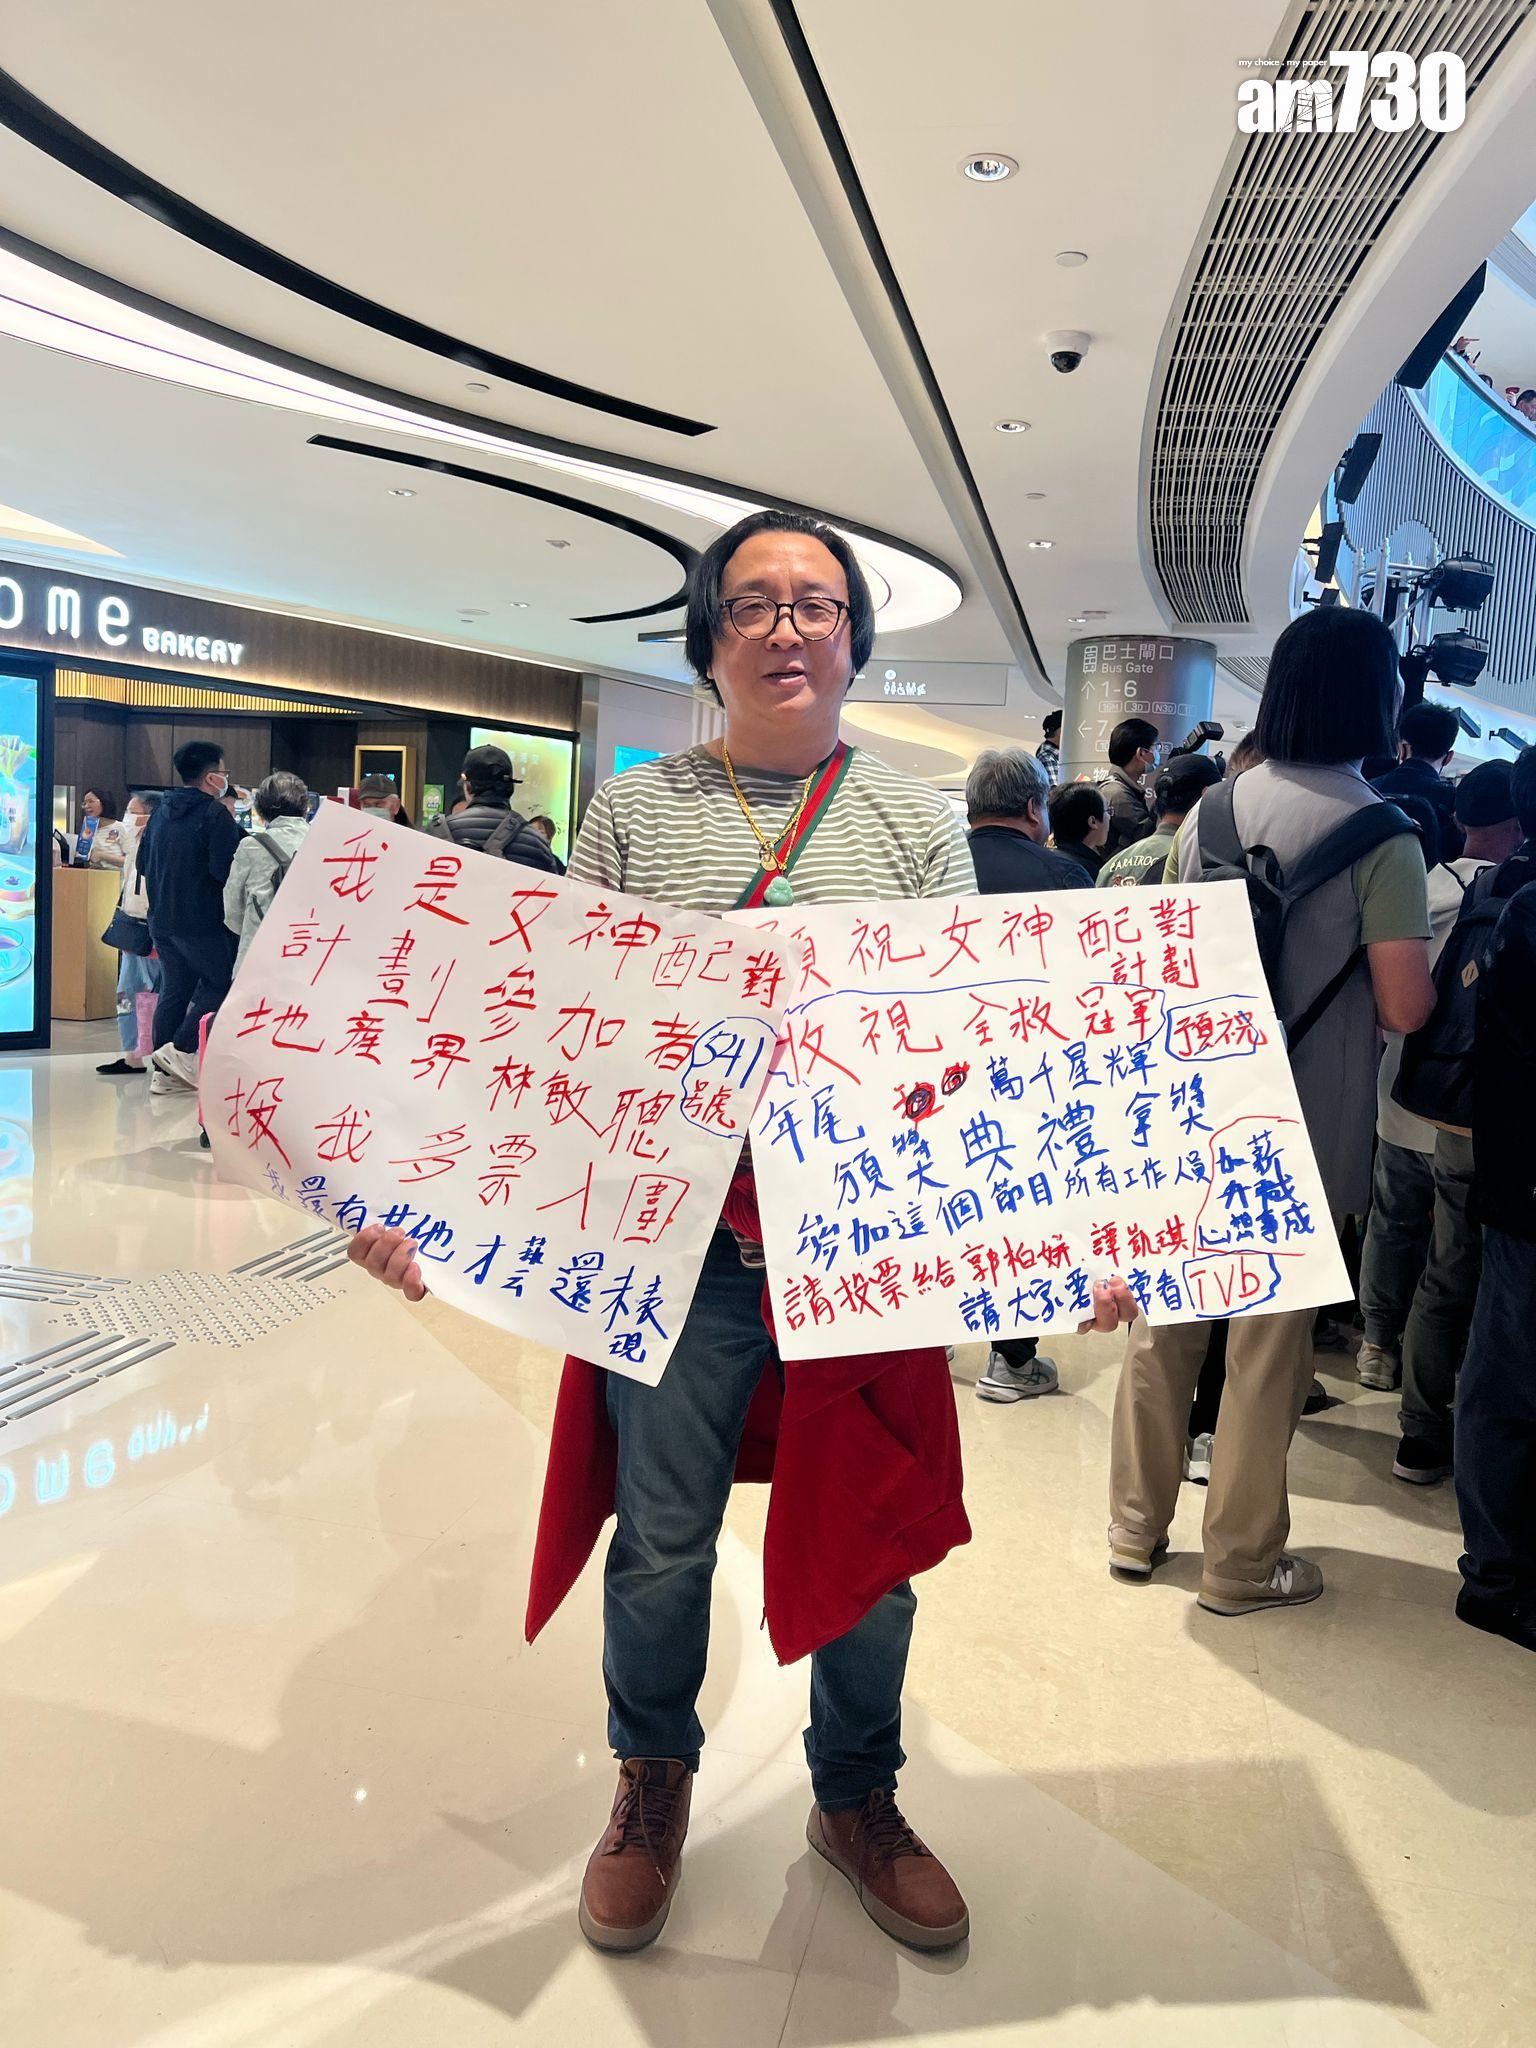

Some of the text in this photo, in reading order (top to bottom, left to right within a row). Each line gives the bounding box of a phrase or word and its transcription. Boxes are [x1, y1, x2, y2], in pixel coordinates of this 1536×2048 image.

[142, 627, 244, 666] BAKERY
[1102, 643, 1174, 661] 巴士閘口
[1101, 662, 1154, 673] Bus Gate
[1131, 702, 1144, 711] 3D
[1155, 703, 1174, 713] N3D
[1110, 944, 1200, 988] 計劃
[759, 1084, 866, 1163] 年尾
